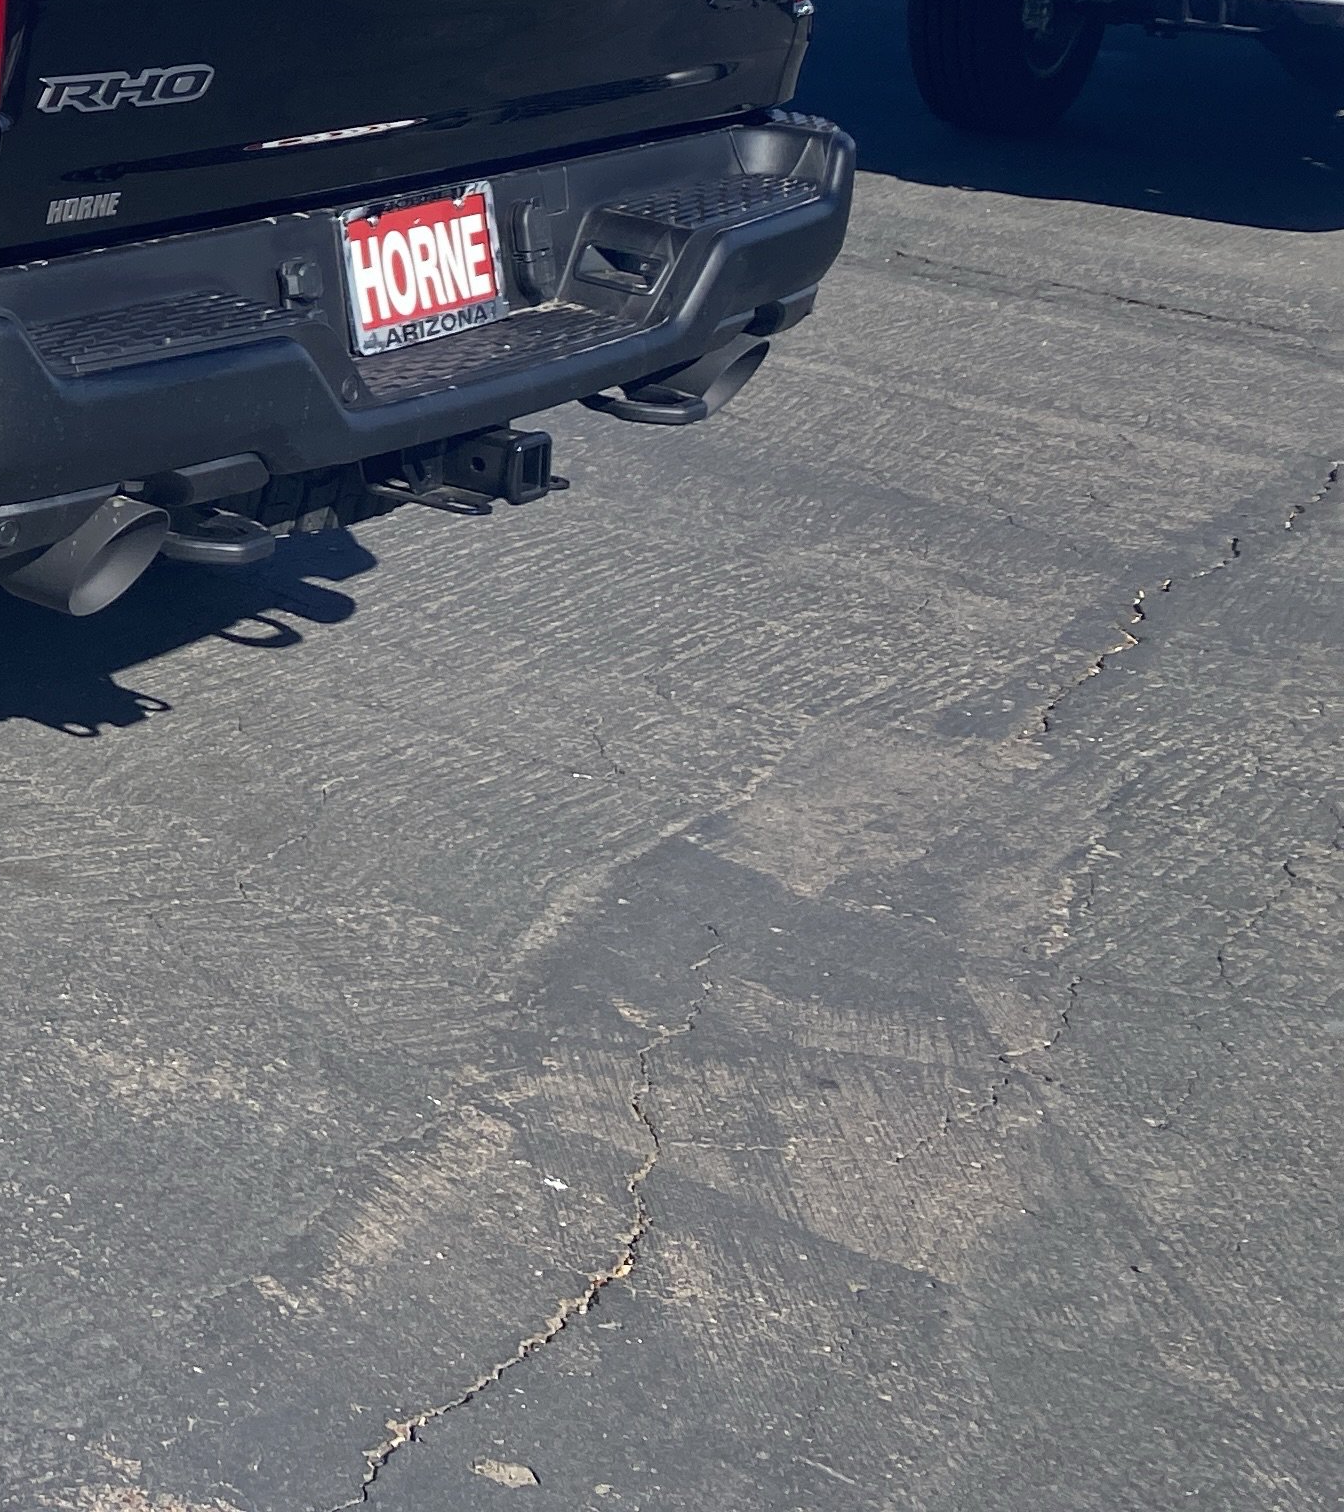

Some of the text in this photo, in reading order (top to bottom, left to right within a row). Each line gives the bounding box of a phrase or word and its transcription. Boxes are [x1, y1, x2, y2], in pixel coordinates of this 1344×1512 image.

[37, 63, 215, 114] RHO
[46, 191, 122, 225] HORNE
[350, 213, 492, 325] HORNE
[386, 305, 488, 348] ARIZONA
